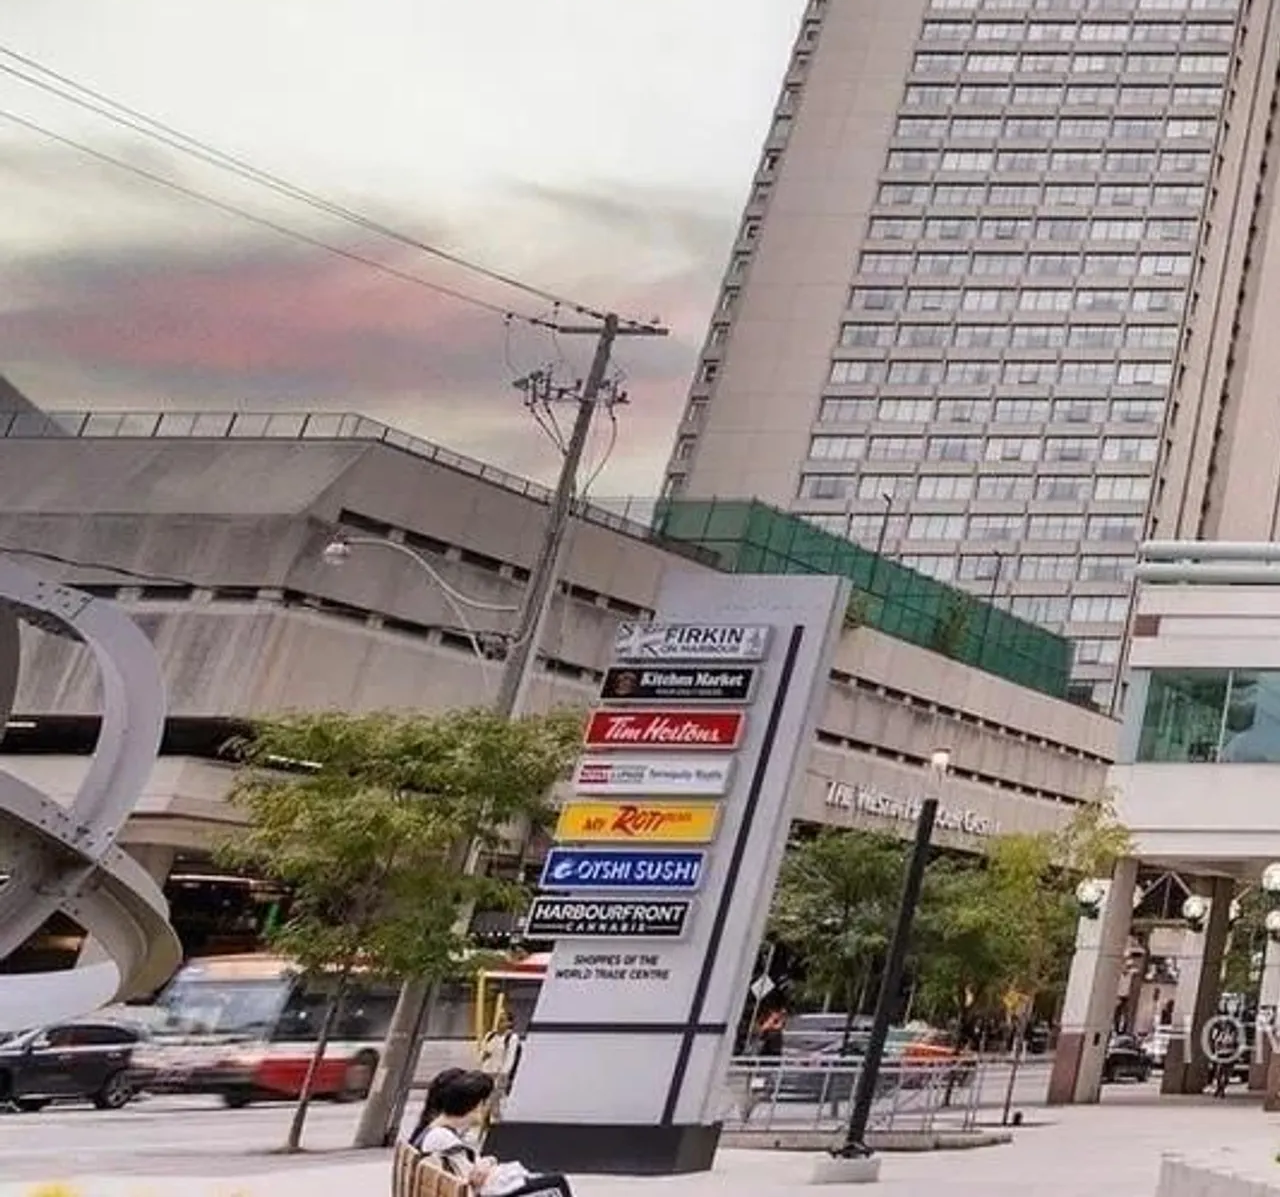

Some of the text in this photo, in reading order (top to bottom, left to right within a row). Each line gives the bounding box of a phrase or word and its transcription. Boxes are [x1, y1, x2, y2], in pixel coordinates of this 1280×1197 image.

[664, 627, 746, 644] FIRKIN
[640, 671, 746, 688] Kitchen Market
[604, 715, 722, 743] Tim Hortons
[633, 861, 700, 881] SUSHI
[534, 904, 685, 922] HARBOURFRONT
[565, 922, 646, 932] CANNABIS
[573, 955, 659, 966] SHOPPES OF THE
[555, 969, 671, 980] WORLD TRADE CENTRE
